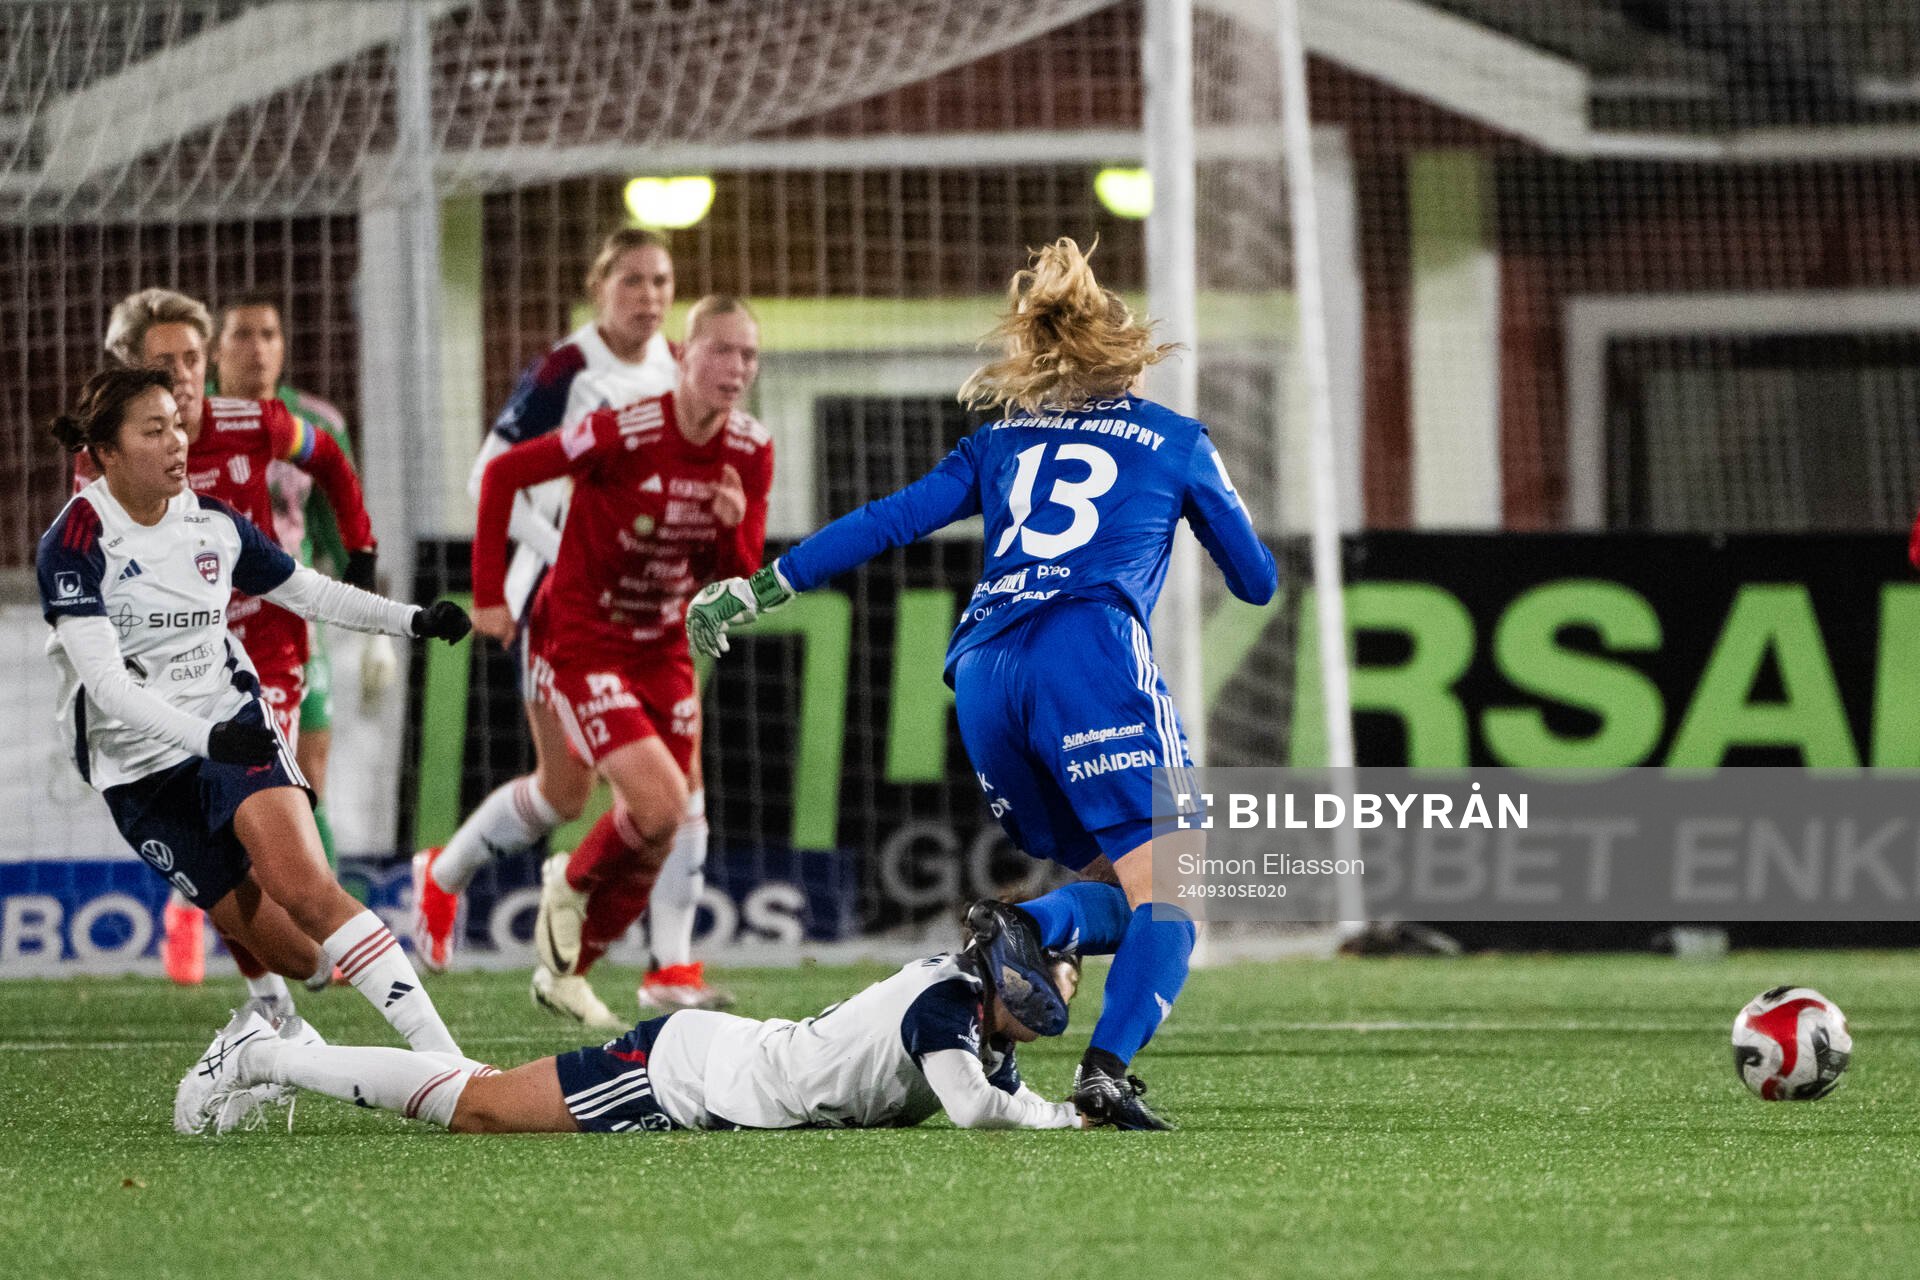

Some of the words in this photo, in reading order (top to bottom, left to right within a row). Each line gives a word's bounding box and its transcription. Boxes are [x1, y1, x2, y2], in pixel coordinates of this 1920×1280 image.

[992, 416, 1080, 431] LESHNAK
[1079, 418, 1166, 452] MURPHY
[993, 441, 1119, 560] 13
[1190, 577, 1920, 783] RSA
[1083, 749, 1157, 778] NÅIDEN
[1668, 817, 1920, 902] ENK
